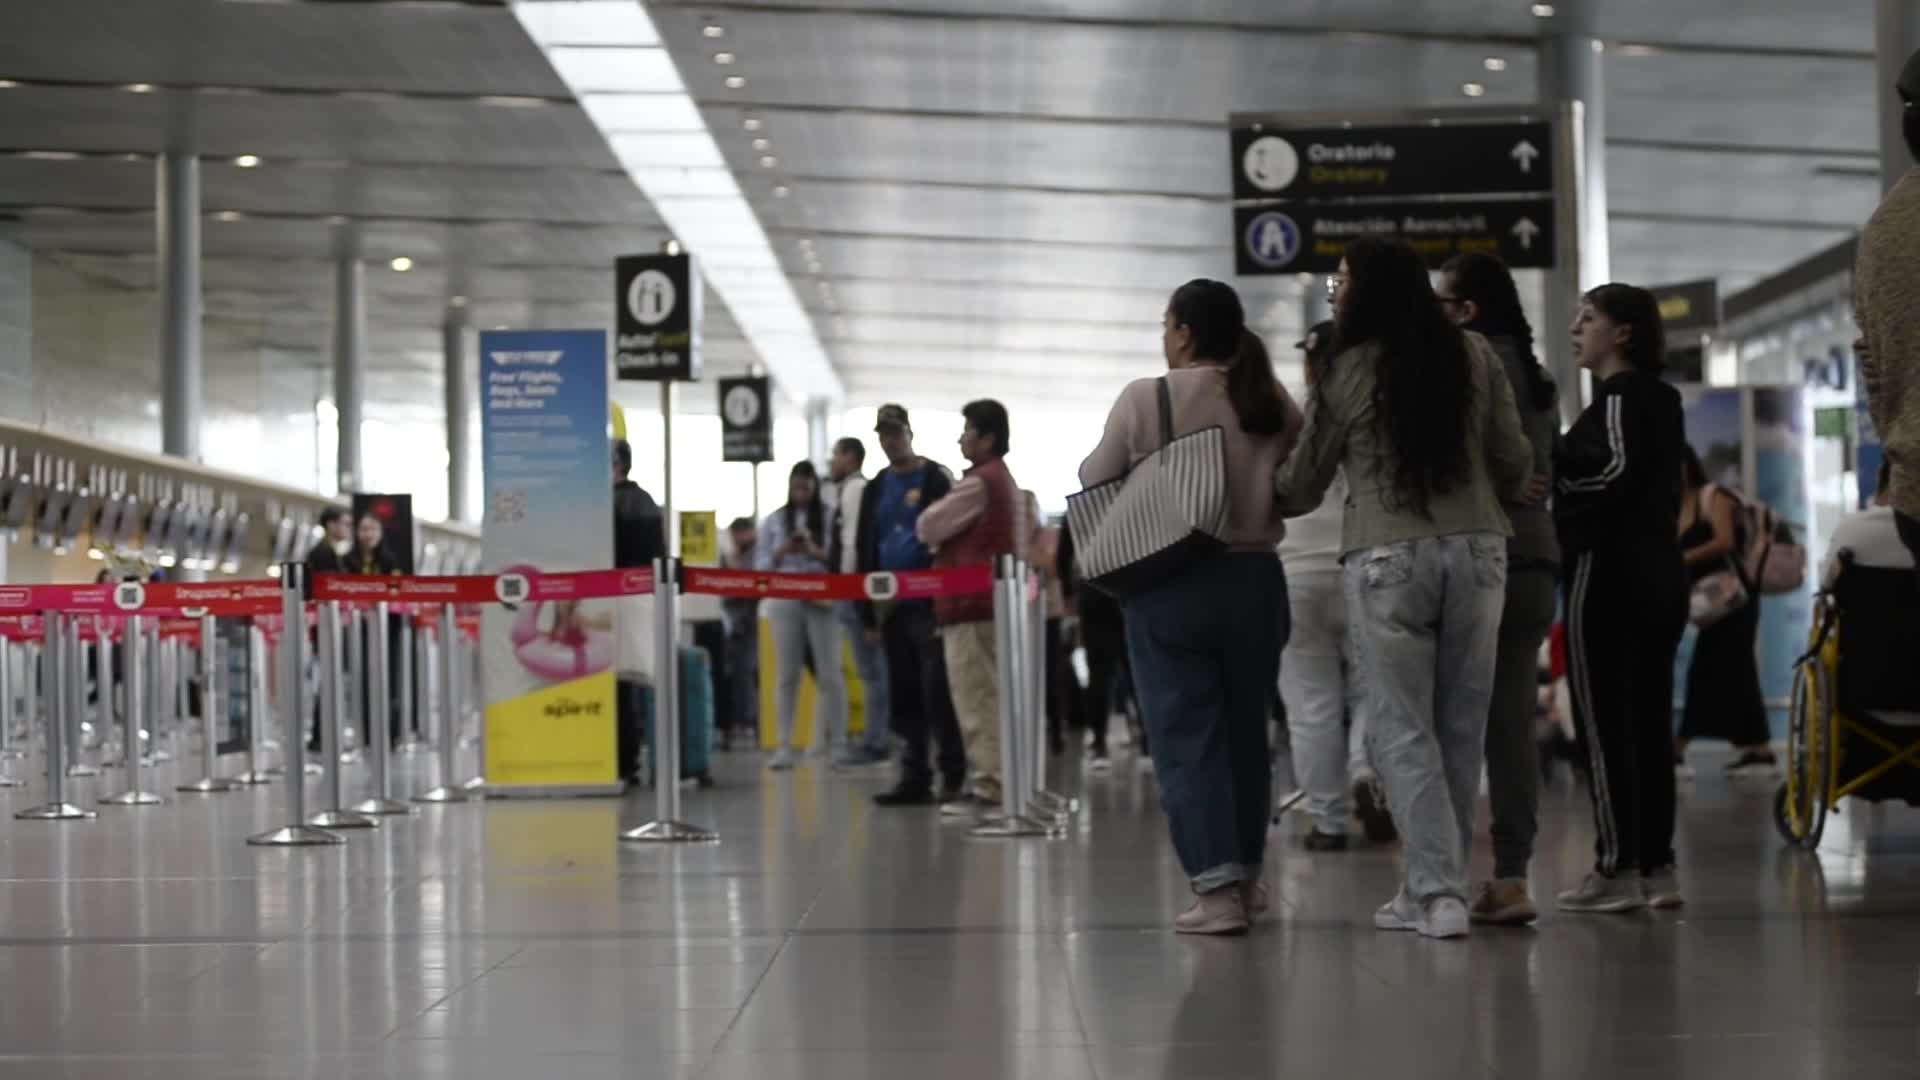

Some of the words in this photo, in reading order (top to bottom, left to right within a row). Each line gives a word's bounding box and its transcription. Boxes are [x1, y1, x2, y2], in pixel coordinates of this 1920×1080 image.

[1308, 142, 1395, 161] Oratorio
[1310, 167, 1389, 187] Oratory
[1312, 216, 1397, 235] Atención
[544, 700, 602, 718] spirit
